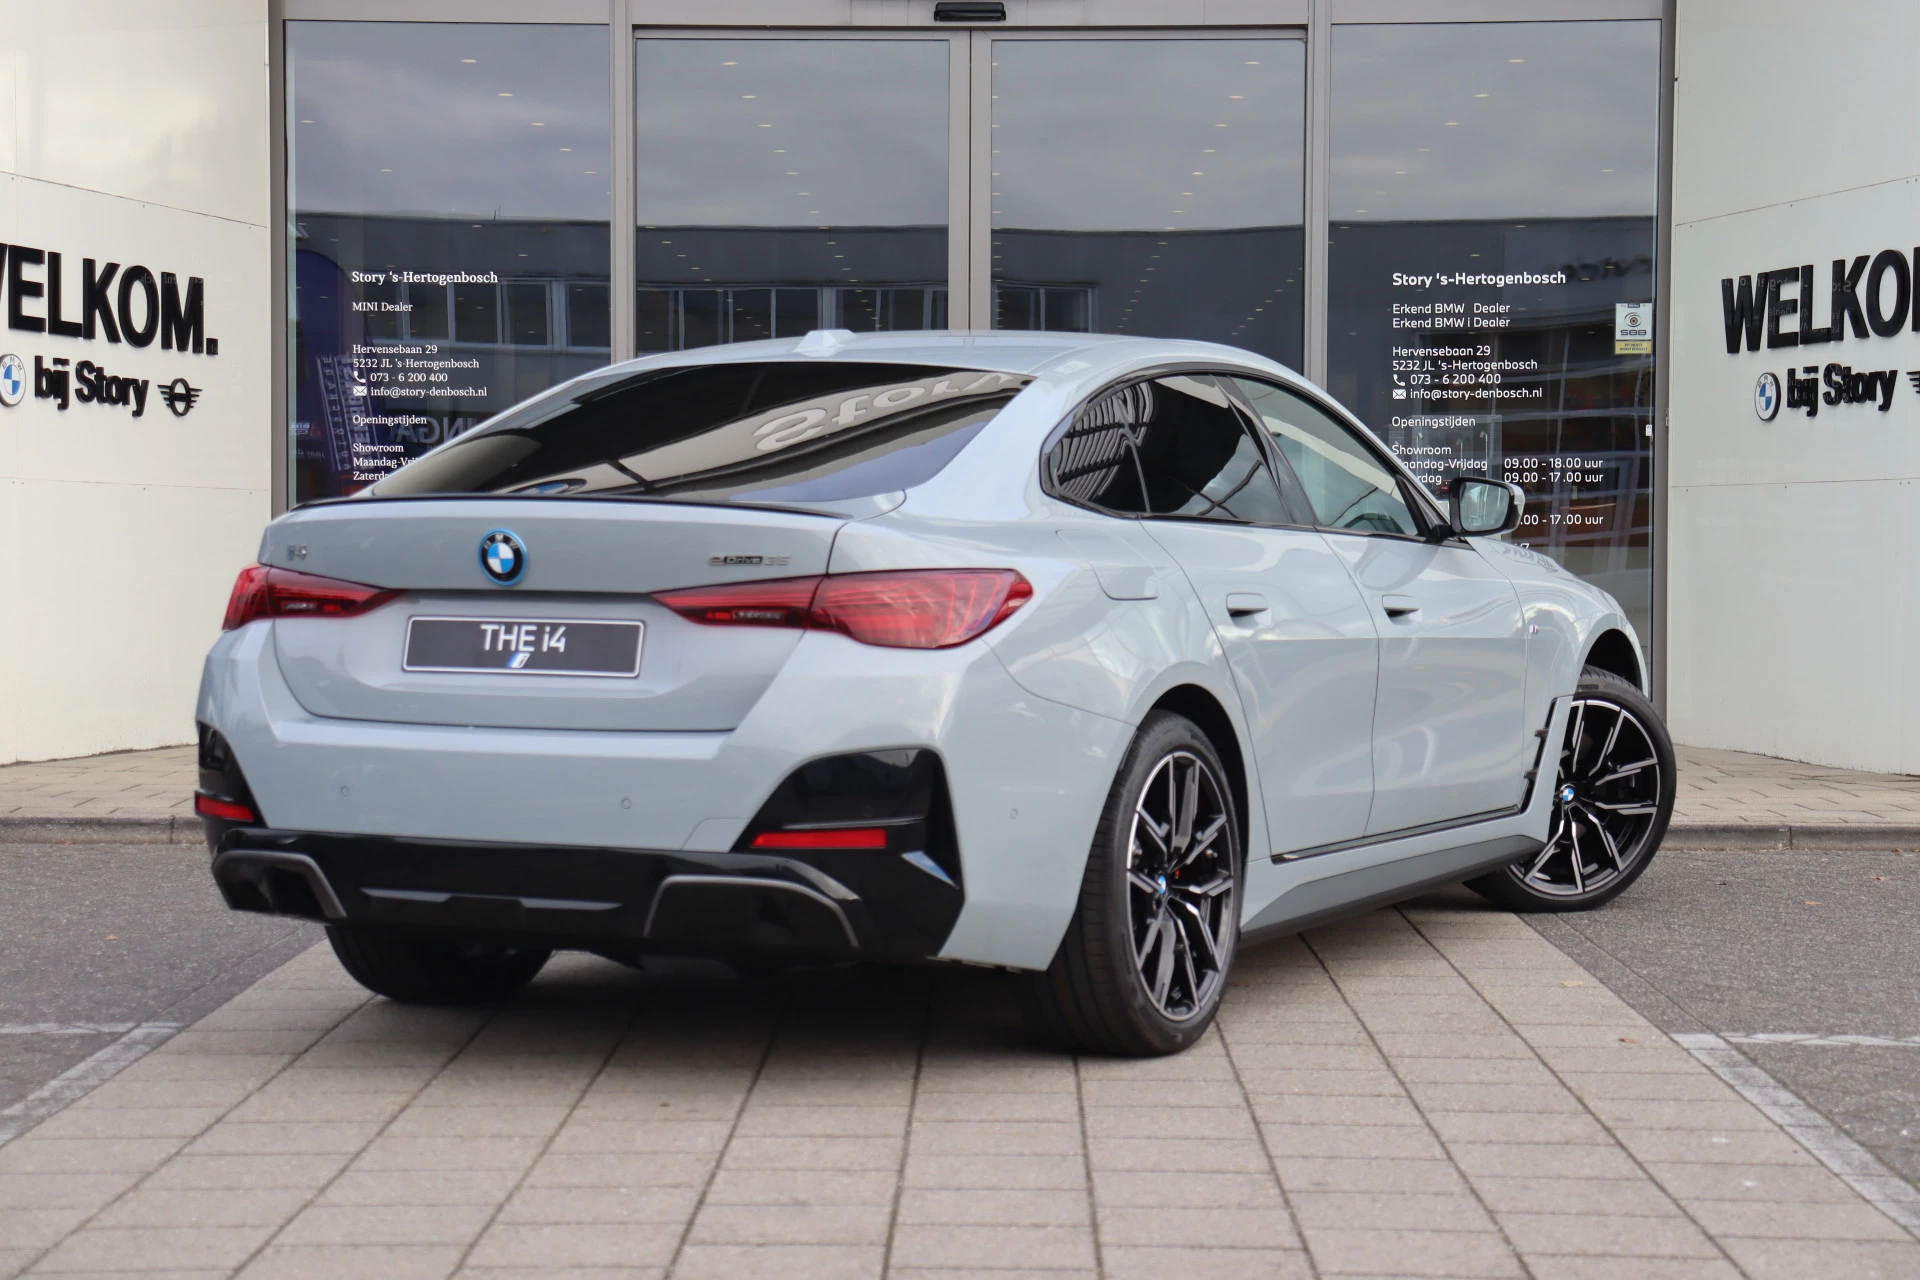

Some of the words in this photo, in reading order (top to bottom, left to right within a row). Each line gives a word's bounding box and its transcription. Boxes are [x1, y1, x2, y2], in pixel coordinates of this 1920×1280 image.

[352, 271, 386, 285] Story
[1392, 272, 1432, 288] Story
[352, 302, 378, 312] MINI
[381, 302, 413, 312] Dealer
[1392, 303, 1432, 314] Erkend
[1434, 303, 1465, 314] BMW
[1473, 302, 1510, 313] Dealer
[1392, 318, 1432, 328] Erkend
[1434, 318, 1465, 328] BMW
[1467, 317, 1471, 327] i
[1473, 317, 1510, 327] Dealer
[353, 345, 422, 354] Hervensebaan
[425, 345, 438, 354] 29
[1392, 346, 1474, 357] Hervensebaan
[1476, 345, 1491, 356] 29
[353, 358, 378, 368] 5232
[380, 358, 393, 368] JL
[1392, 360, 1420, 371] 5232
[1422, 360, 1435, 371] JL
[370, 372, 389, 382] 073
[398, 372, 405, 382] 6
[407, 372, 426, 382] 200
[429, 372, 448, 382] 400
[1410, 374, 1431, 385] 073
[1442, 374, 1450, 385] 6
[1452, 374, 1475, 385] 200
[1478, 374, 1501, 384] 400
[34, 355, 70, 411] bij
[75, 360, 150, 417] Story
[1787, 366, 1819, 417] bij
[1822, 363, 1898, 412] Story
[370, 387, 488, 398] info@story-denbosch.nl
[1410, 388, 1543, 400] info@story-denbosch.nl
[353, 414, 427, 427] Openingstijden
[1391, 416, 1476, 428] Openingstijden
[353, 443, 404, 452] Showroom
[1391, 445, 1452, 455] Showroom
[1398, 459, 1488, 471] aandag-Vrijdag
[1504, 458, 1538, 469] 09.00
[1549, 458, 1581, 469] 18.00
[1584, 459, 1604, 468] uur
[1504, 472, 1538, 483] 09.00
[1584, 473, 1604, 482] uur
[1585, 516, 1604, 525] uur
[480, 624, 537, 652] THE
[542, 625, 567, 653] i4
